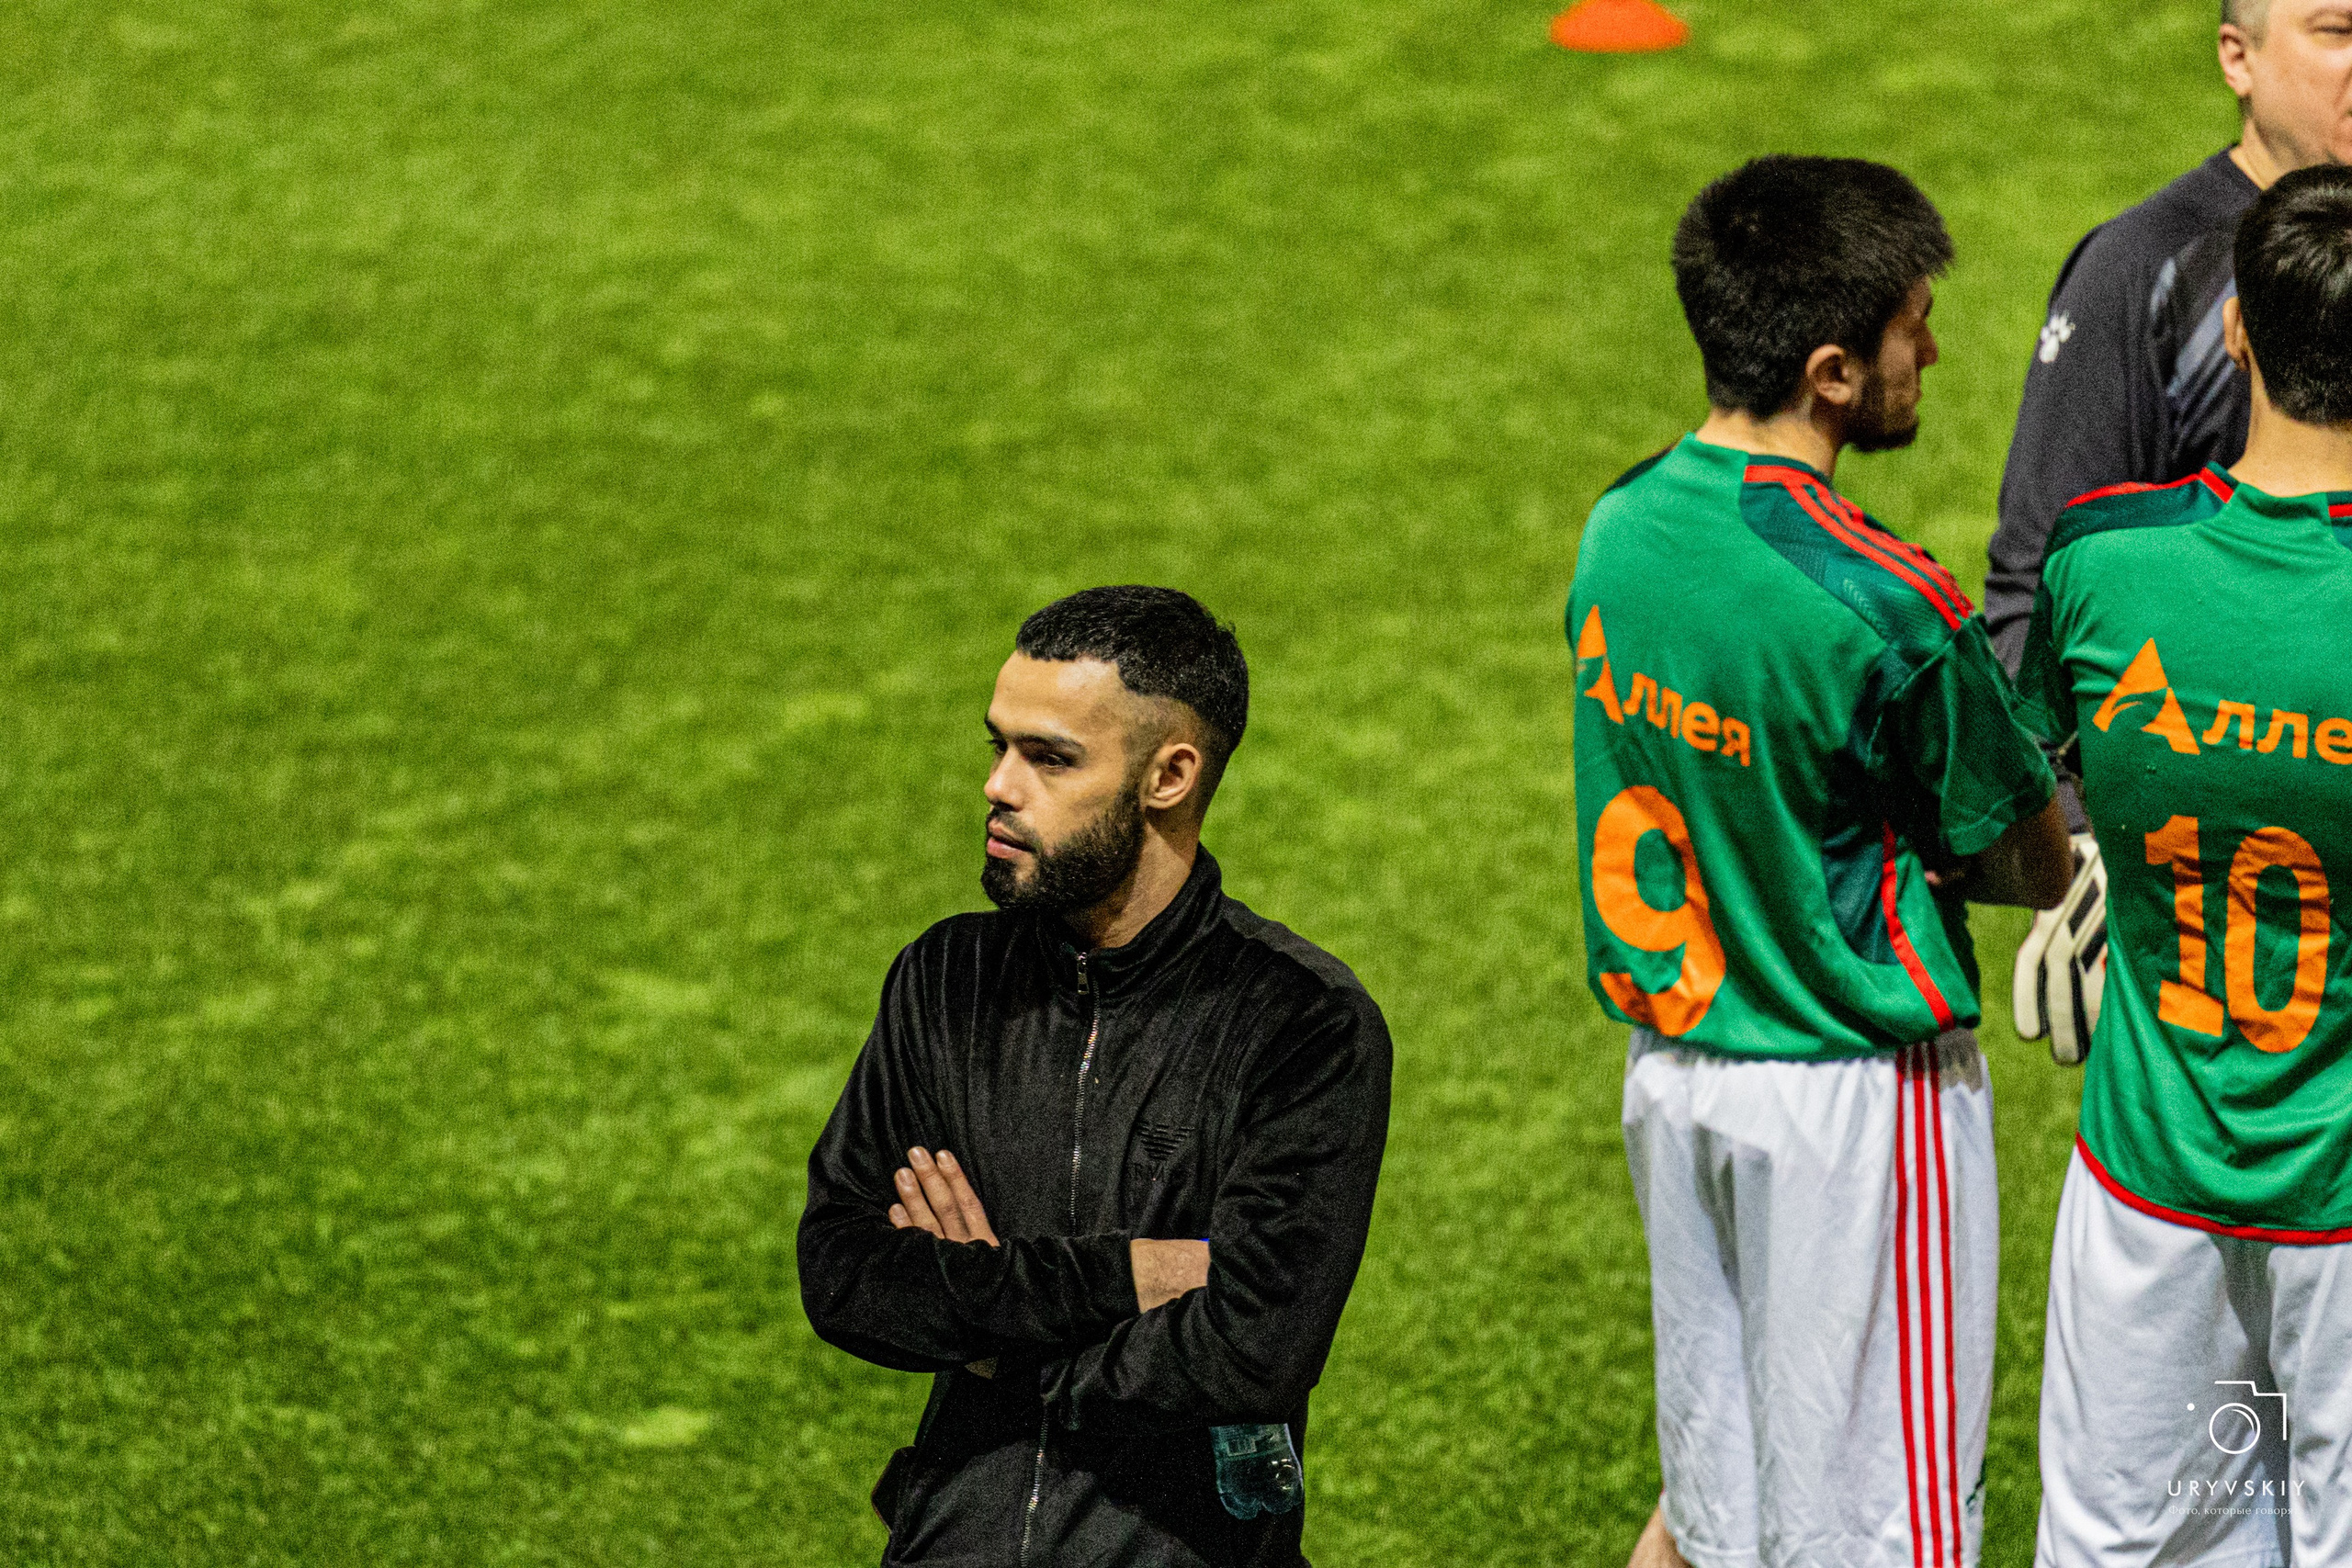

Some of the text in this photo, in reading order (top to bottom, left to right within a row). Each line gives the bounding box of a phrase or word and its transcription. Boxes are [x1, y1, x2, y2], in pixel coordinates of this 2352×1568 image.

[1577, 605, 1750, 766] Аллея
[1592, 785, 1726, 1036] 9
[2144, 815, 2330, 1053] 10
